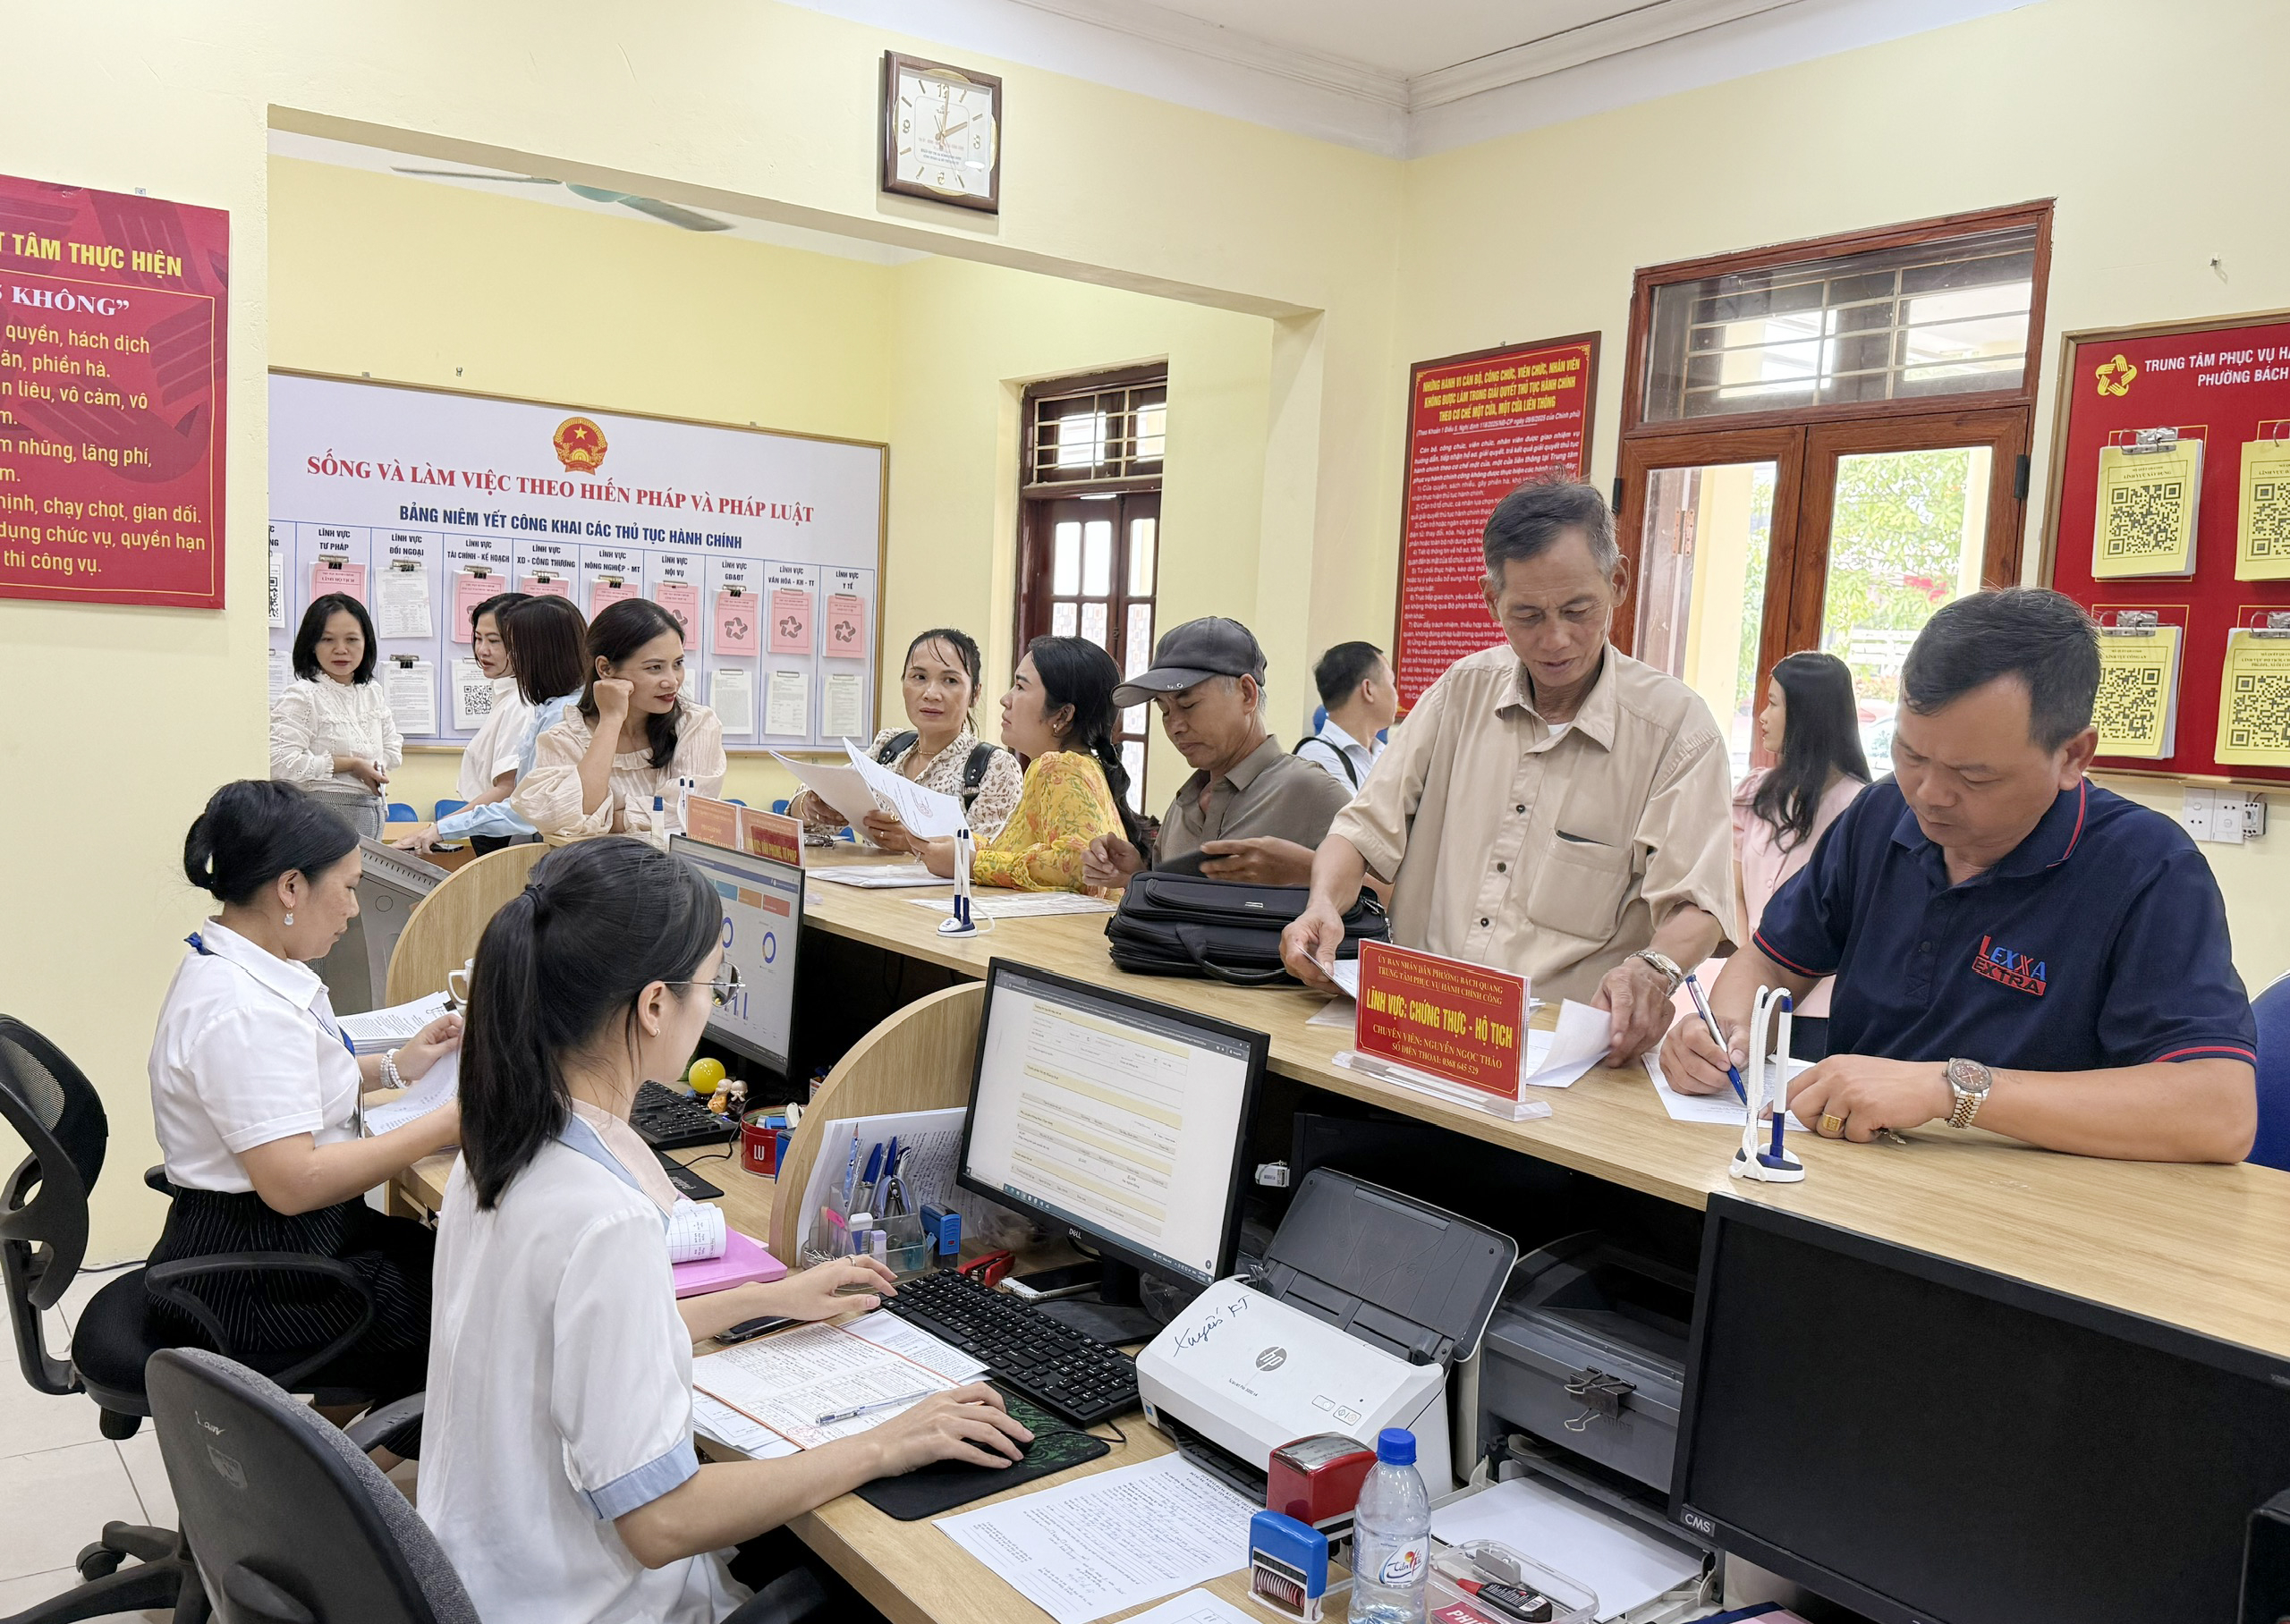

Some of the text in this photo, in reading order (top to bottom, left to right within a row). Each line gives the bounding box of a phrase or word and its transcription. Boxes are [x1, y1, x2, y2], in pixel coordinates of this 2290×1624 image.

[903, 119, 911, 133] 9
[973, 134, 980, 149] 3
[13, 232, 182, 279] TÂM THỰC HIỆN
[12, 285, 130, 317] KHÔNG”
[6, 324, 150, 355] quyền, hách dịch
[32, 354, 81, 375] phiền
[86, 359, 111, 378] hà.
[2145, 356, 2185, 372] TRUNG
[2189, 351, 2215, 368] TÂM
[2218, 349, 2253, 367] PHỤC
[2257, 347, 2276, 364] VỤ
[2197, 366, 2289, 387] PHƯỜNG BÁCH
[18, 380, 55, 402] liêu,
[59, 386, 79, 402] vô
[84, 388, 124, 410] cảm,
[129, 393, 148, 409] vô
[19, 437, 152, 468] nhũng, lãng phí,
[307, 448, 814, 526] SỐNG VÀ LÀM VIỆC THEO HIẾN PHÁP VÀ PHÁP LUẬT
[44, 496, 83, 520] chạy
[89, 500, 129, 521] chọt,
[133, 503, 167, 523] gian
[173, 504, 201, 523] dối.
[46, 526, 88, 544] chức
[92, 531, 116, 548] vụ,
[121, 529, 171, 550] quyền
[176, 533, 205, 553] hạn
[318, 528, 351, 539] LĨNH VỰC
[391, 534, 422, 545] LĨNH VỰC
[400, 502, 742, 549] BẢNG NIÊM YẾT CÔNG KHAI CÁC THỦ TỤC HÀNH CHÍNH
[319, 542, 350, 551] TƯ PHÁP
[389, 546, 425, 556] ĐỐI NGOẠI
[4, 550, 102, 576] thi công vụ.
[665, 567, 685, 578] NỘI VỤ
[1979, 935, 2047, 981] LEXXA
[1378, 966, 1503, 1005] TRUNG TÂM PHỤC VỤ HÀNH CHÍNH CÔNG
[1387, 958, 1400, 967] BAN
[1400, 960, 1417, 971] NHÂN
[1418, 965, 1431, 976] DÂN
[1432, 968, 1459, 983] PHƯỜNG
[1460, 975, 1479, 986] BÁCH
[1479, 980, 1504, 994] QUANG
[1974, 959, 2040, 994] EXTRA
[1367, 985, 1386, 1012] LĨNH
[1387, 993, 1407, 1020] VỰC:
[1410, 999, 1439, 1028] CHỨNG
[1443, 1007, 1466, 1037] THỰC
[1475, 1014, 1488, 1046] HỘ
[1490, 1022, 1513, 1049] TỊCH
[1373, 1024, 1503, 1070] CHUYÊN VIÊN: NGUYỄN NGỌC THẢO
[1392, 1041, 1401, 1052] SỐ
[1418, 1050, 1442, 1064] THOẠI:
[1442, 1056, 1456, 1069] 0368
[1456, 1061, 1468, 1072] 645
[1469, 1064, 1479, 1076] 529
[754, 1144, 765, 1161] LU
[1069, 1228, 1081, 1239] DELL
[1257, 1346, 1287, 1372] hp
[1685, 1513, 1710, 1533] CMS
